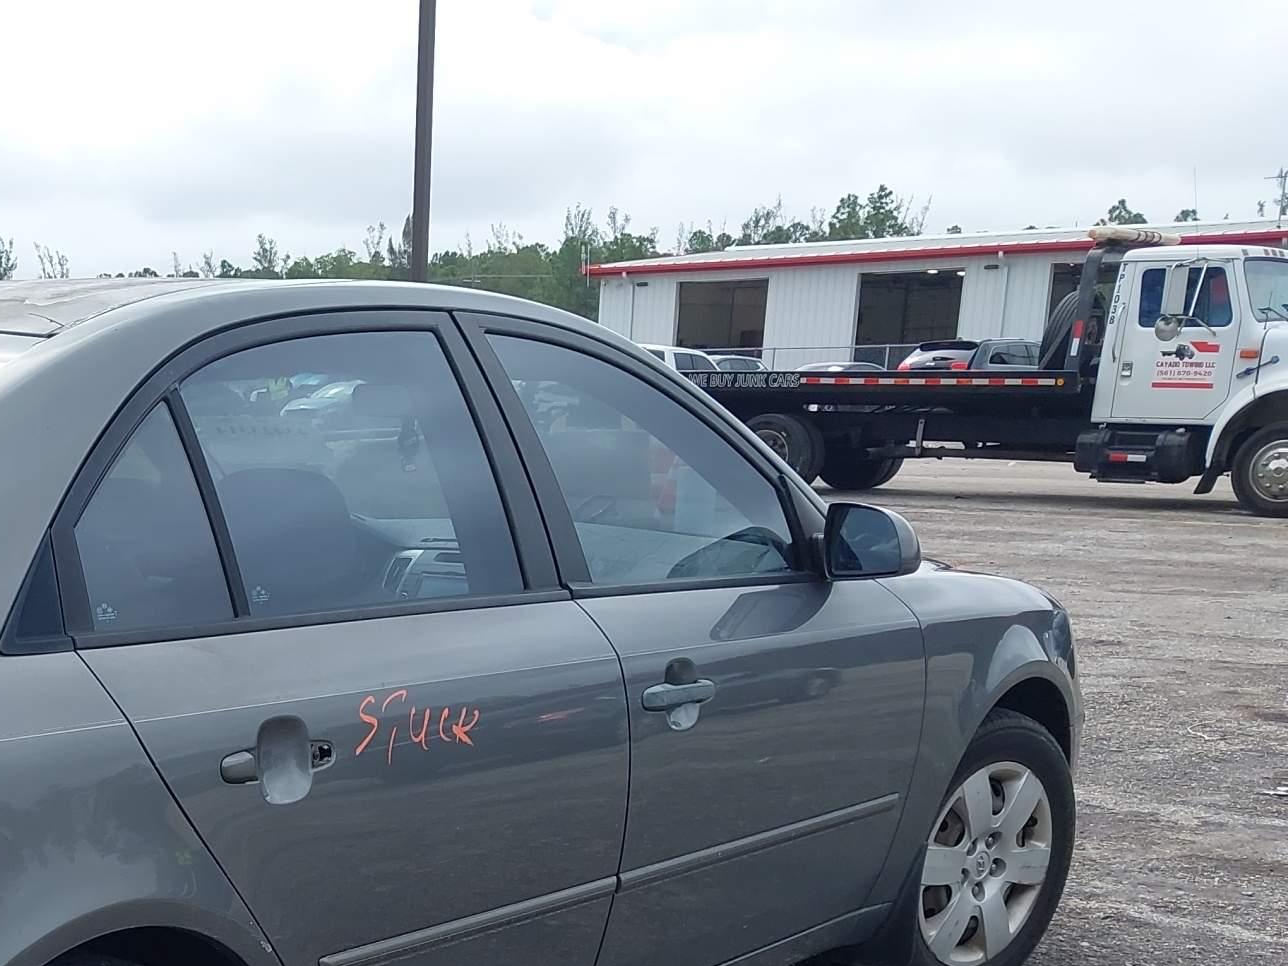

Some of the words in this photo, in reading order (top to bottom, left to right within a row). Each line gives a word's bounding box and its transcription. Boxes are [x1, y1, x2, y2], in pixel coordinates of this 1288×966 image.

[688, 373, 708, 387] WE
[710, 373, 734, 387] BUY
[735, 373, 767, 388] JUNK
[768, 373, 801, 388] CARS
